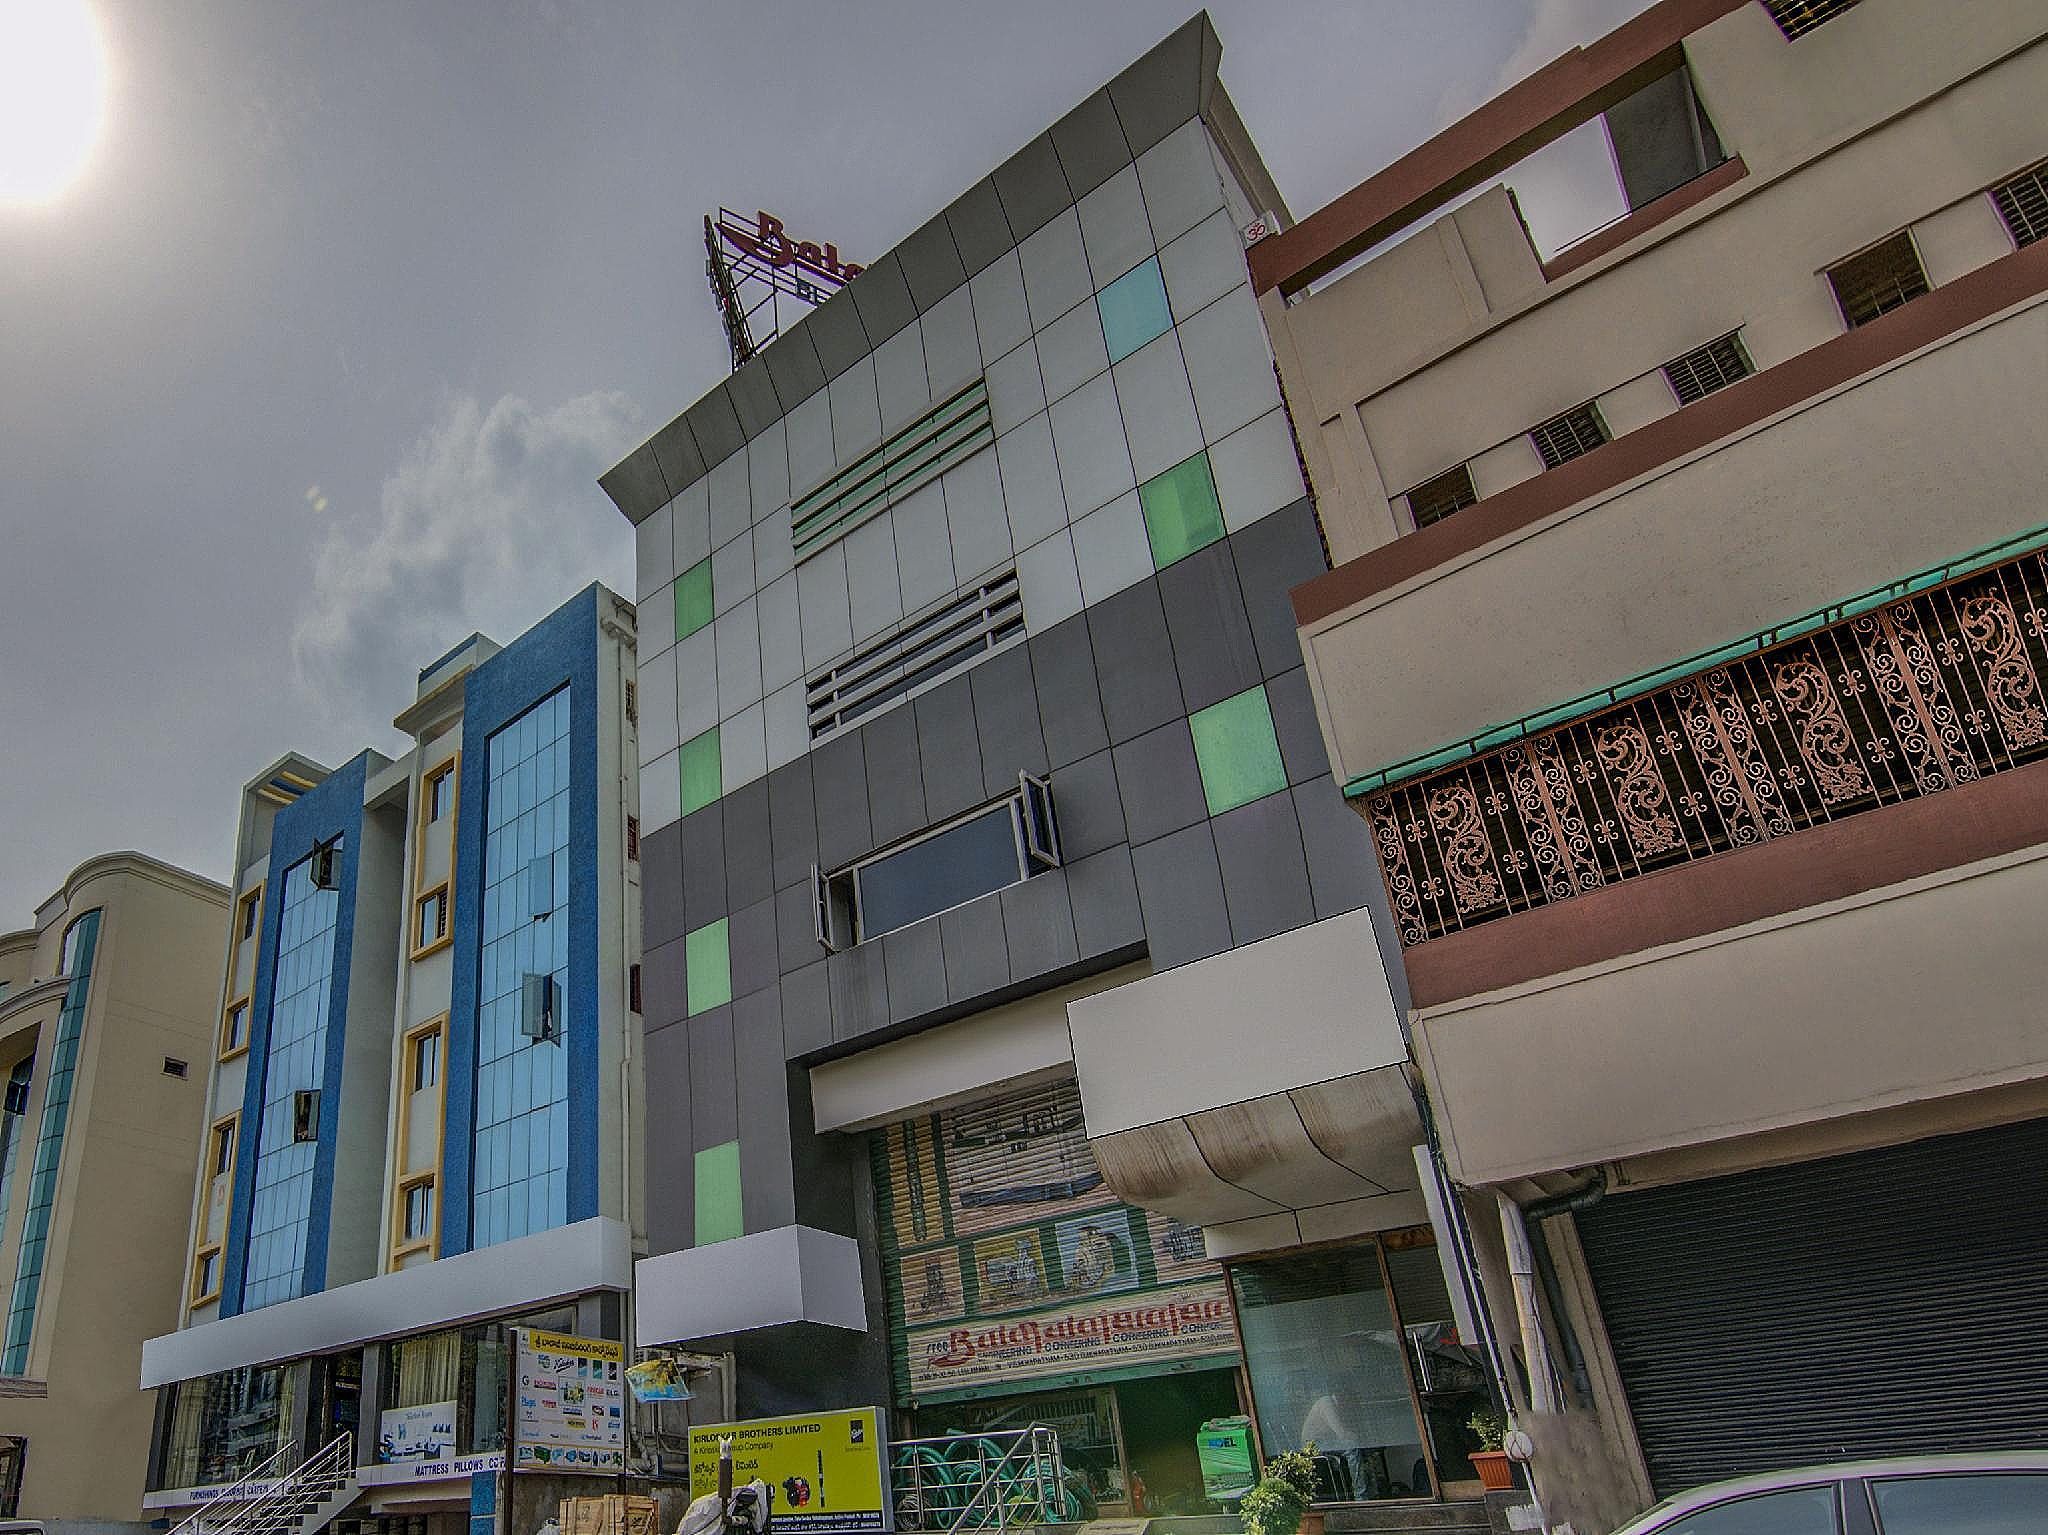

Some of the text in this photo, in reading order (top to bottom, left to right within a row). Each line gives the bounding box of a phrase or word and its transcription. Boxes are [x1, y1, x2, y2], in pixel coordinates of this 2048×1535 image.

[740, 1427, 783, 1439] BROTHERS
[785, 1423, 821, 1435] LIMITED
[415, 1463, 449, 1476] MATTRESS
[454, 1458, 483, 1472] PILLOWS
